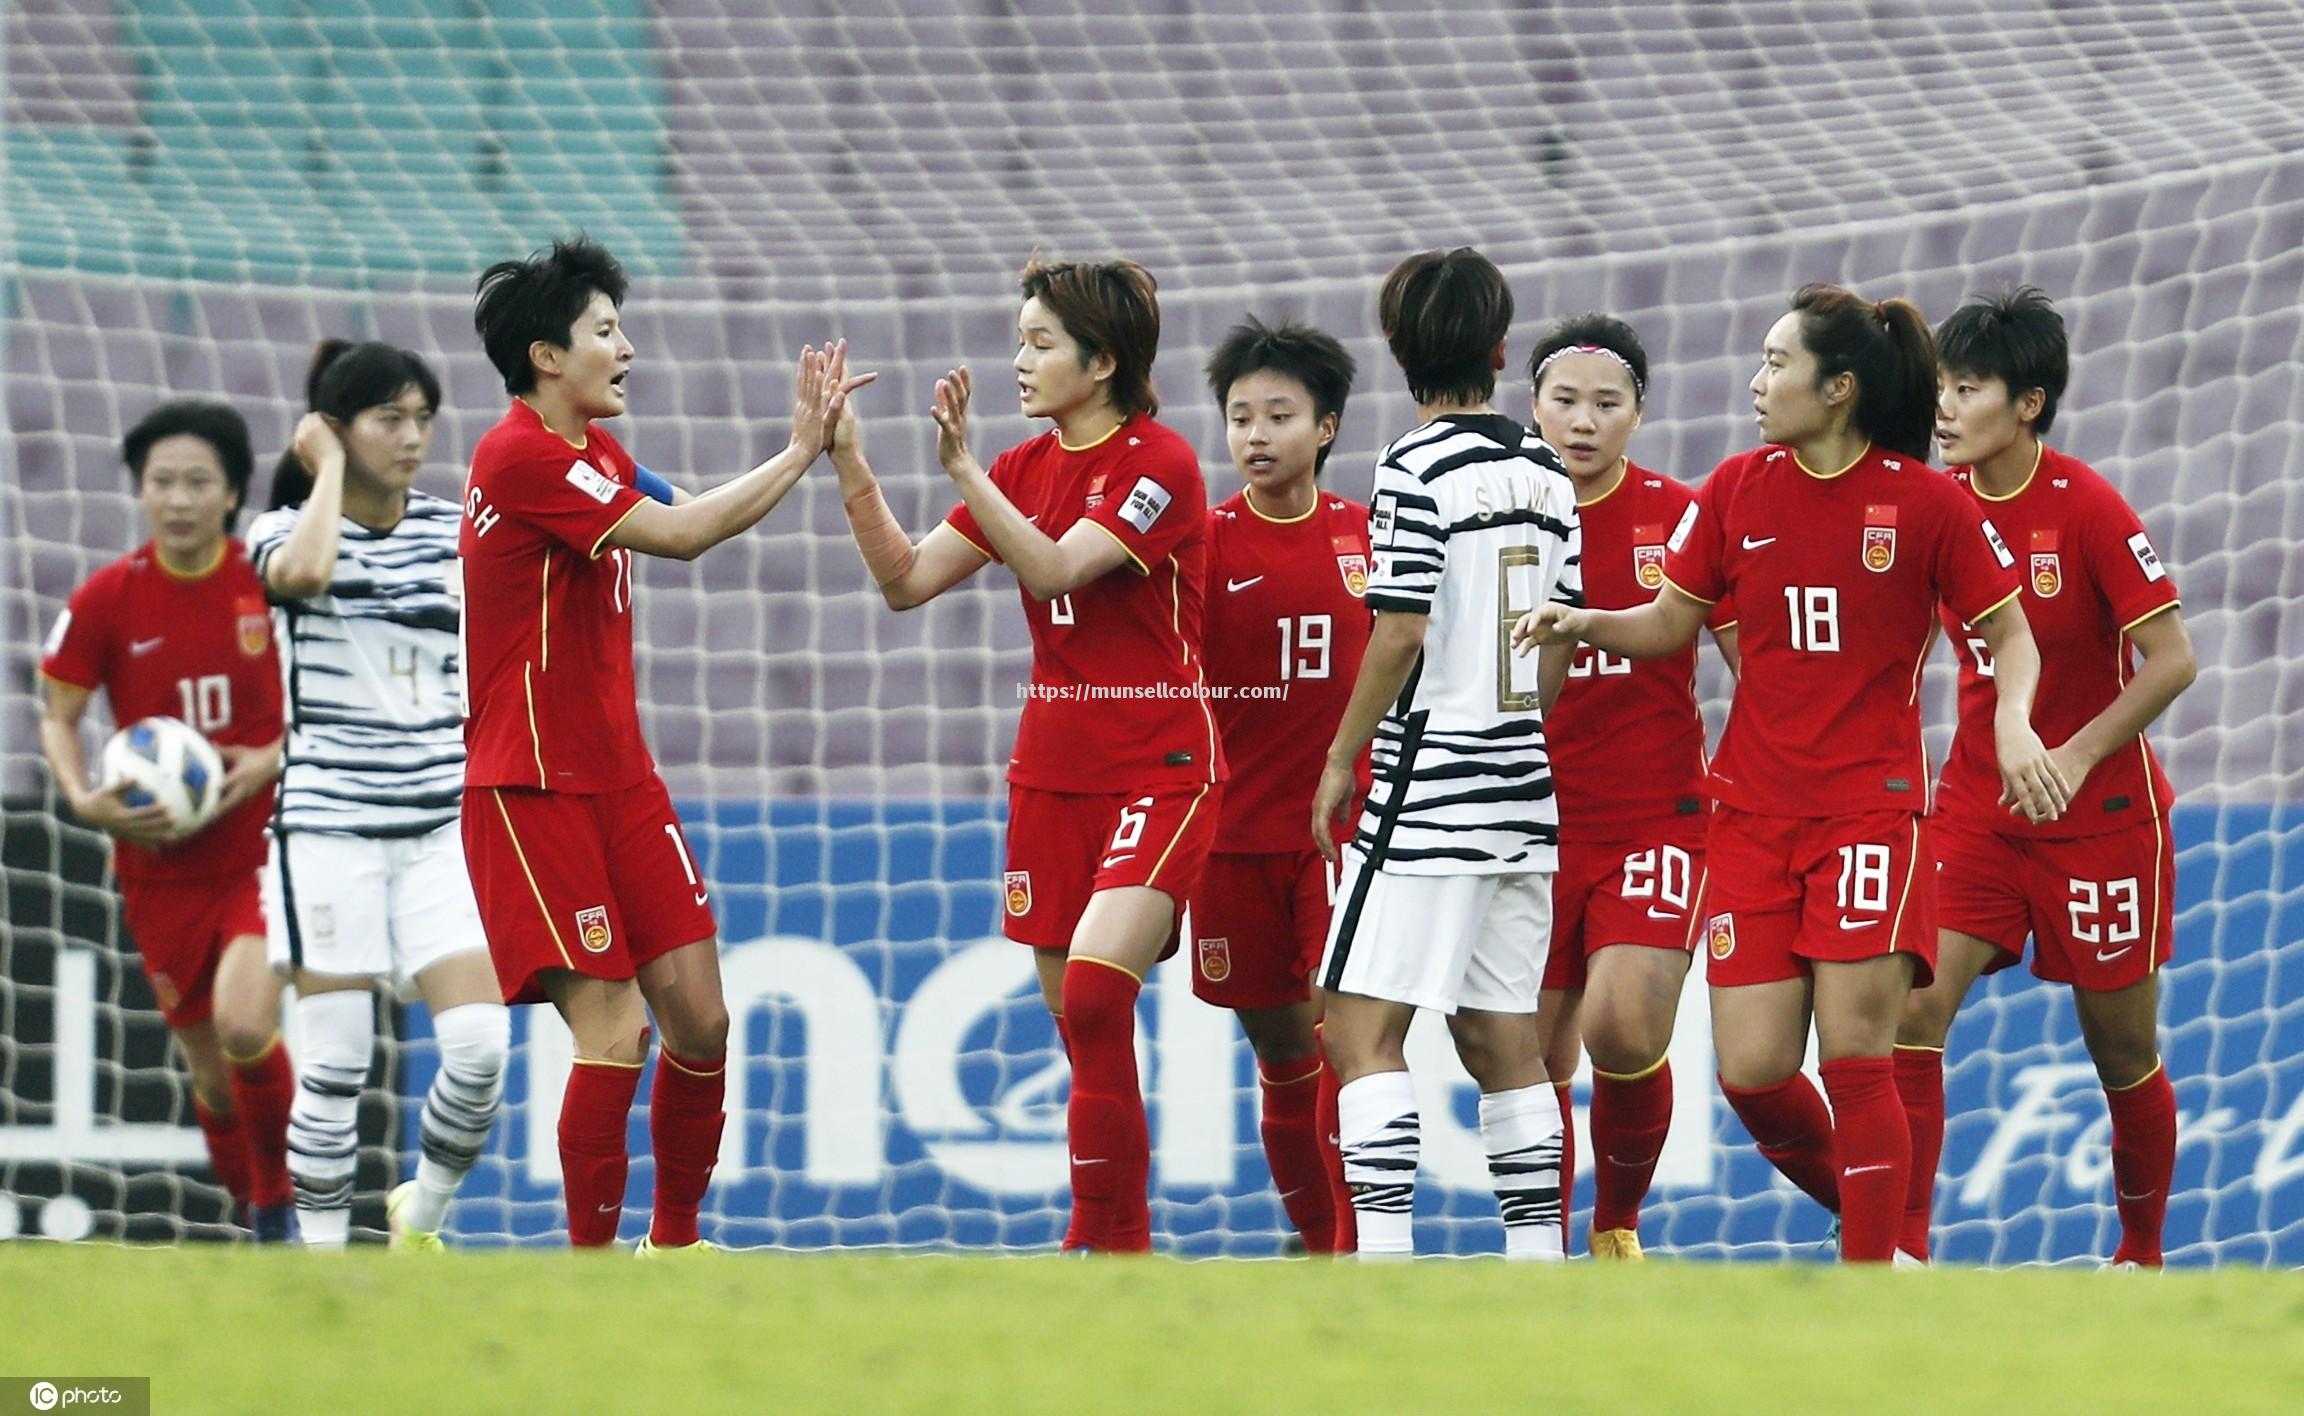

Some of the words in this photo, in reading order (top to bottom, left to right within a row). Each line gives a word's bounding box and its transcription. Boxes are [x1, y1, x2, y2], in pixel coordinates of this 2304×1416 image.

[1277, 614, 1332, 680] 19
[1784, 586, 1840, 652] 18
[178, 673, 232, 733] 10
[388, 644, 419, 706] 4
[1620, 844, 1690, 909] 20
[1836, 843, 1890, 911] 18
[2067, 877, 2140, 943] 23
